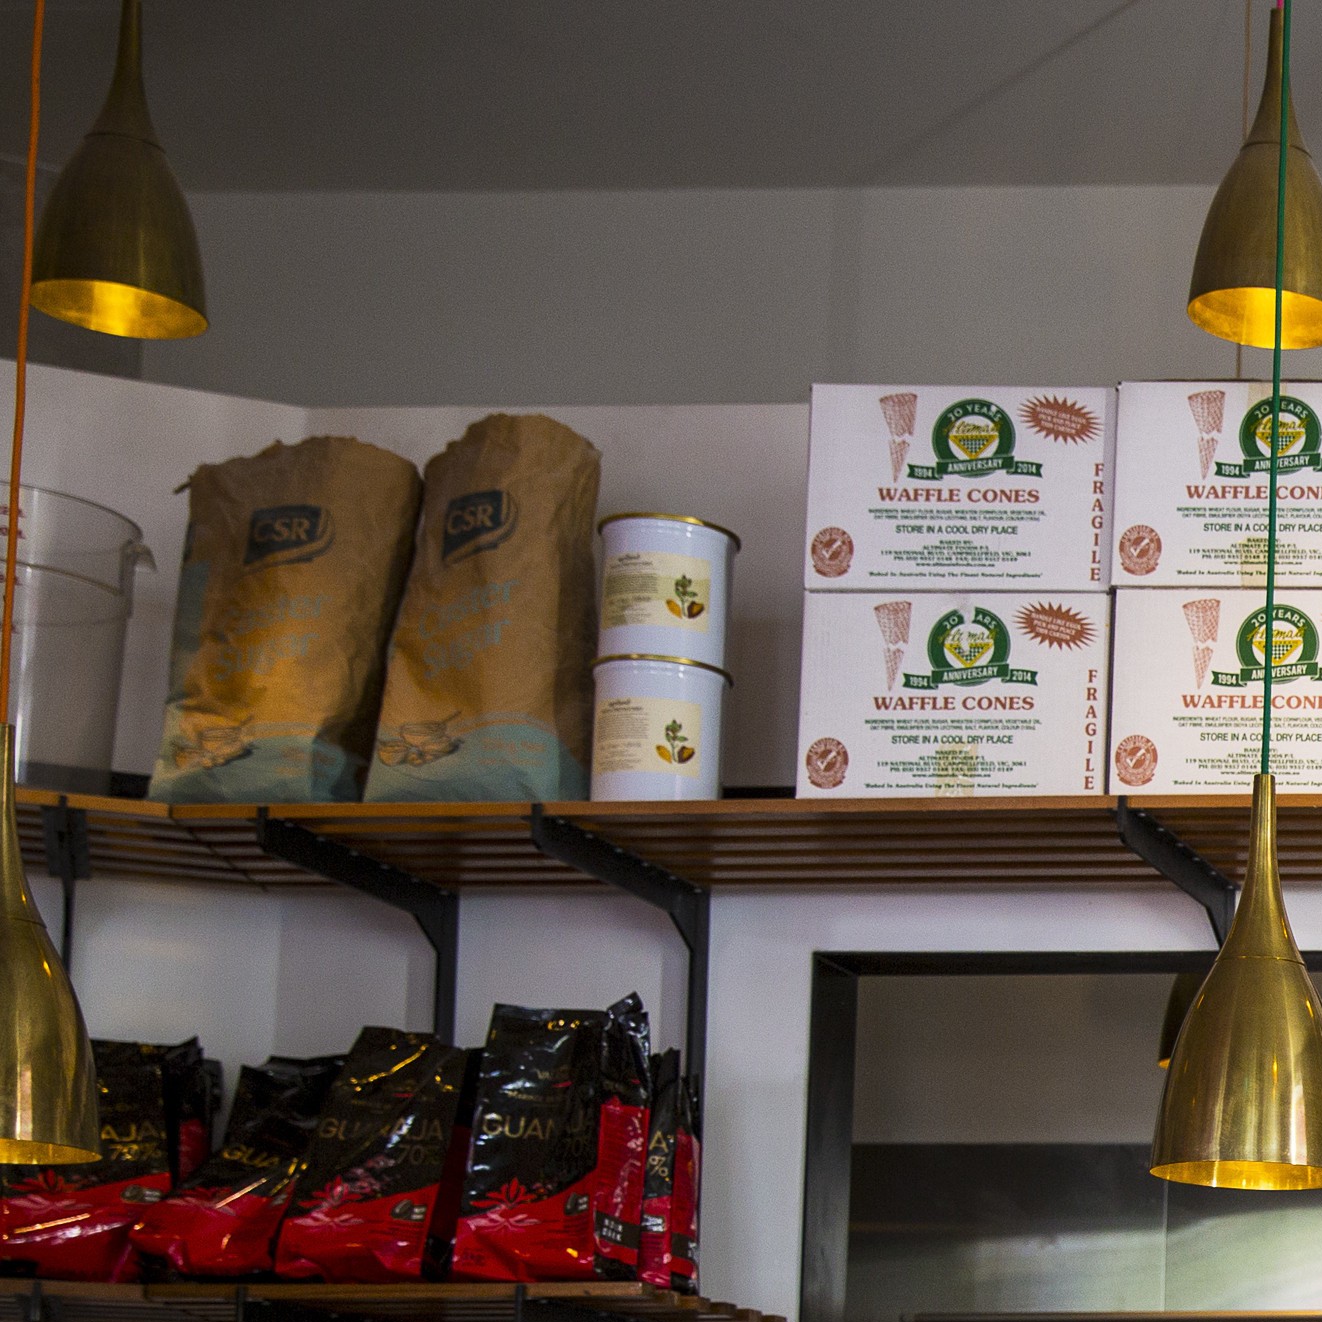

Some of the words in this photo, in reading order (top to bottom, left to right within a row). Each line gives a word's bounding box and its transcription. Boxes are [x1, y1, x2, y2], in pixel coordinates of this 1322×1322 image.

[1255, 405, 1270, 417] 20
[1017, 464, 1036, 474] 2014
[1222, 465, 1240, 476] 1994
[877, 488, 960, 503] WAFFLE
[966, 489, 1039, 503] CONES
[1186, 485, 1267, 500] WAFFLE
[448, 505, 494, 534] CSR
[1090, 464, 1105, 582] FRAGILE
[254, 518, 310, 543] CSR
[1251, 614, 1266, 626] 20
[909, 677, 928, 687] 1994
[943, 666, 999, 682] ANNIVERSARY
[1012, 672, 1031, 681] 2014
[1218, 674, 1236, 685] 1994
[873, 696, 956, 711] WAFFLE
[961, 696, 1034, 711] CONES
[1182, 694, 1264, 709] WAFFLE
[1084, 669, 1098, 790] FRAGILE
[1200, 733, 1228, 741] STORE
[1276, 733, 1292, 741] DRY
[1296, 734, 1322, 742] PLACE
